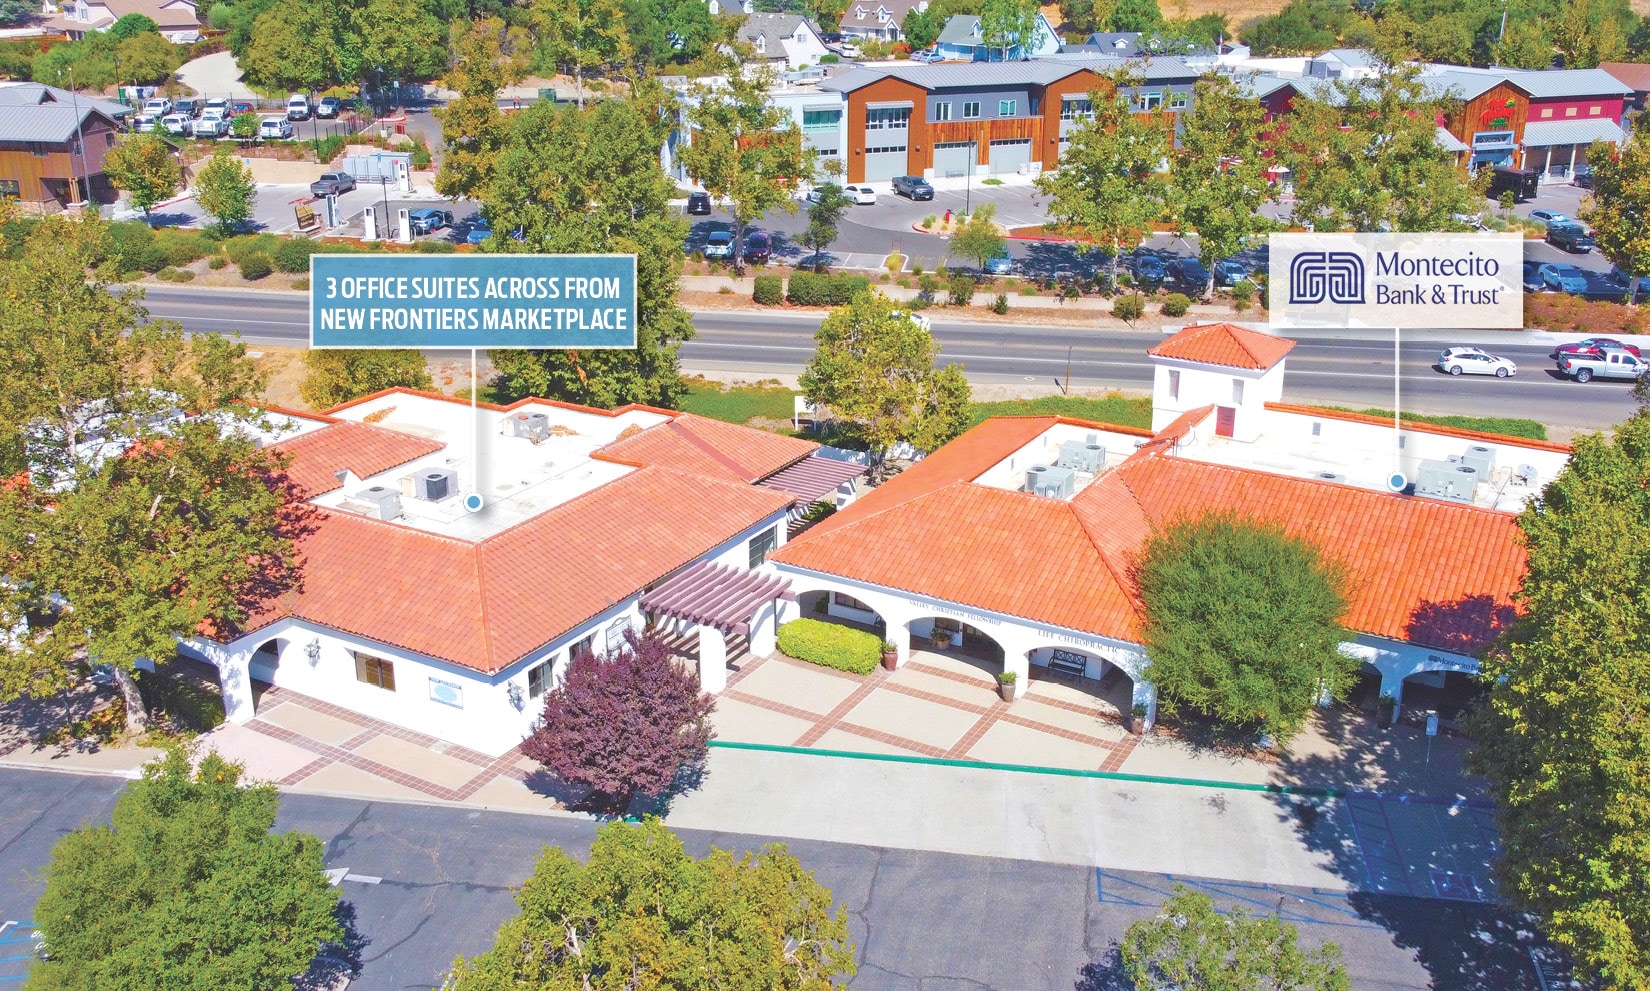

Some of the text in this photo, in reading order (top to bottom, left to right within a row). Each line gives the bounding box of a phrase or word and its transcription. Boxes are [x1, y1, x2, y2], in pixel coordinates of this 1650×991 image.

[909, 600, 929, 610] VALLEY
[931, 606, 965, 618] CHRISTIAN
[1038, 629, 1121, 653] LIFE CHIROPRACTIC
